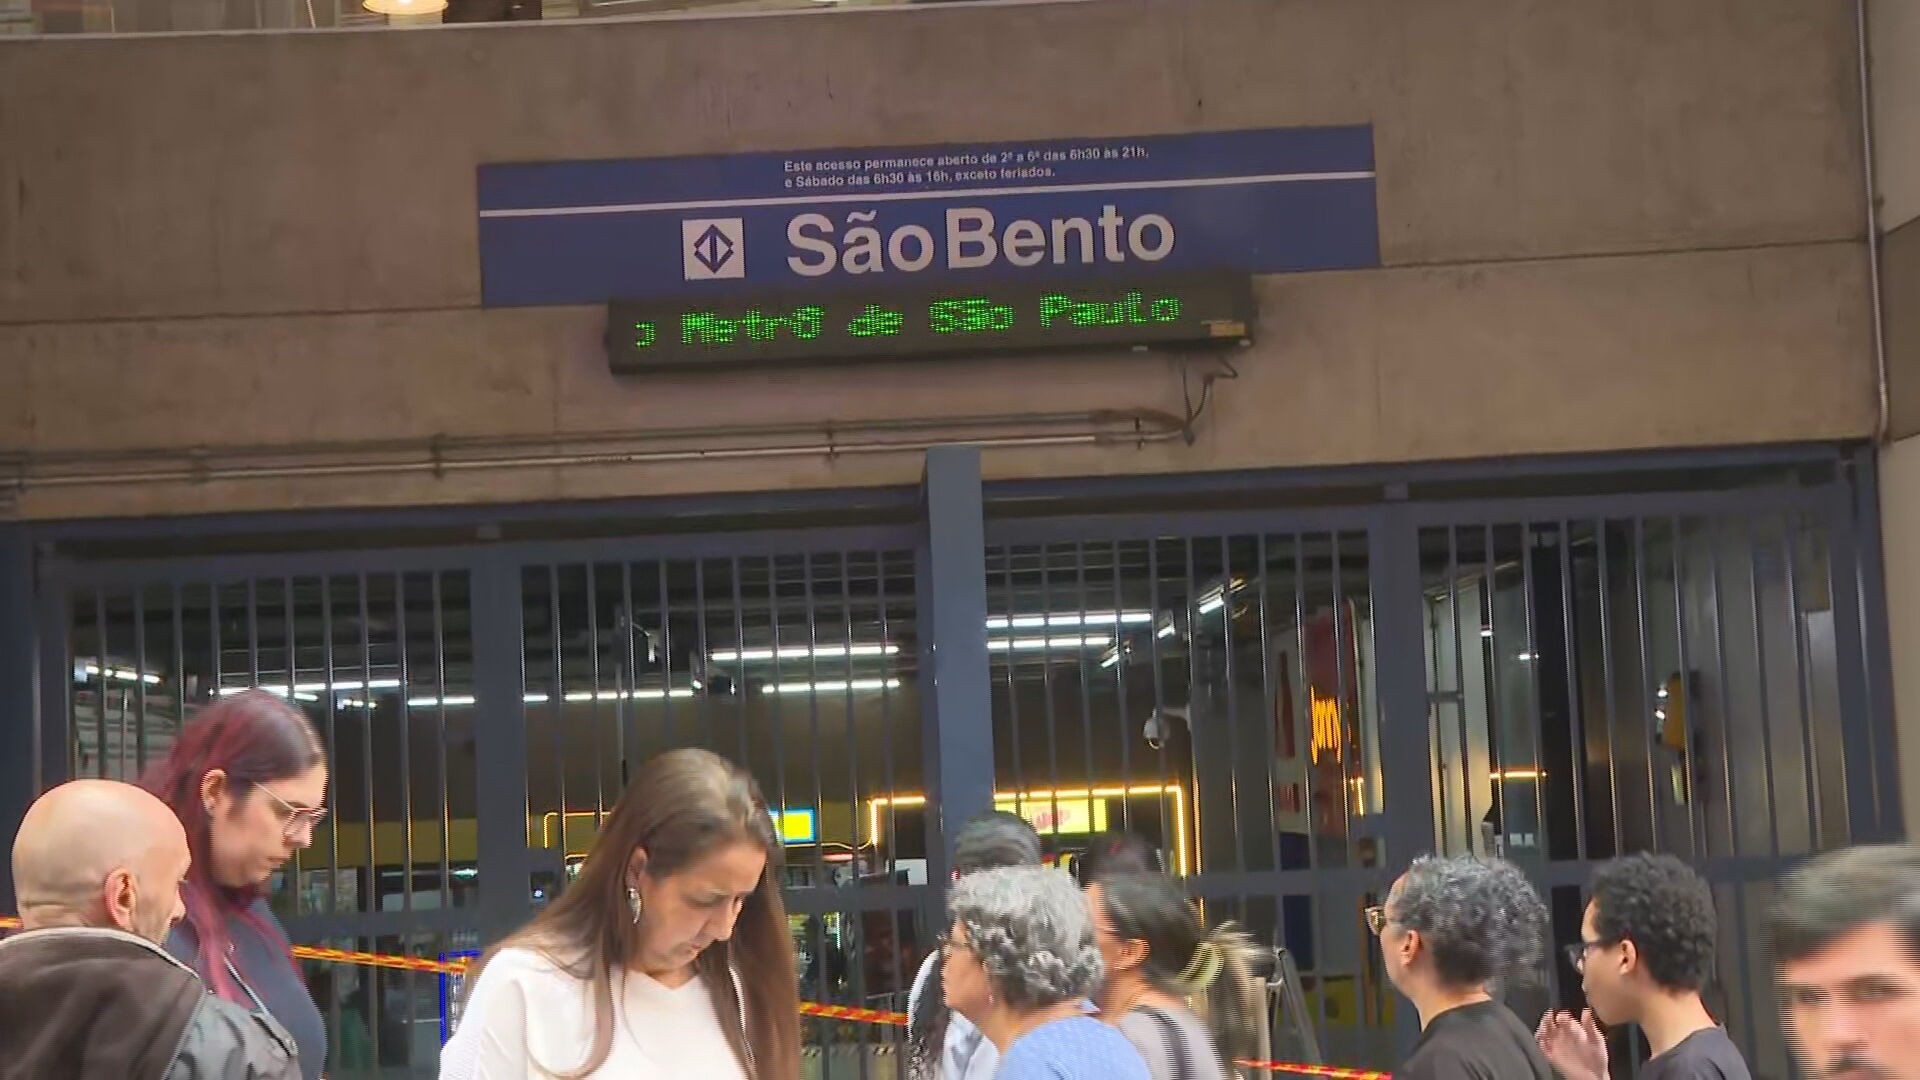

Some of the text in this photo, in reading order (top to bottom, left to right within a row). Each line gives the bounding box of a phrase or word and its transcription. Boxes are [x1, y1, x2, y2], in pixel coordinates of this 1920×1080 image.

[784, 161, 812, 172] Este
[816, 159, 861, 171] acesso
[865, 156, 933, 171] permanece
[938, 153, 978, 167] aberto
[982, 152, 997, 165] de
[1017, 152, 1024, 162] a
[1044, 149, 1066, 161] das
[1070, 147, 1099, 160] 6h30
[1104, 146, 1118, 159] às
[1122, 146, 1149, 159] 21h,
[784, 166, 1055, 188] e Sábado das 6h30 às 16h, exceto feriados.
[787, 204, 1176, 276] São Bento
[681, 304, 824, 345] Metrô
[847, 304, 904, 337] de
[929, 297, 1015, 333] São
[1039, 289, 1181, 328] Paulo
